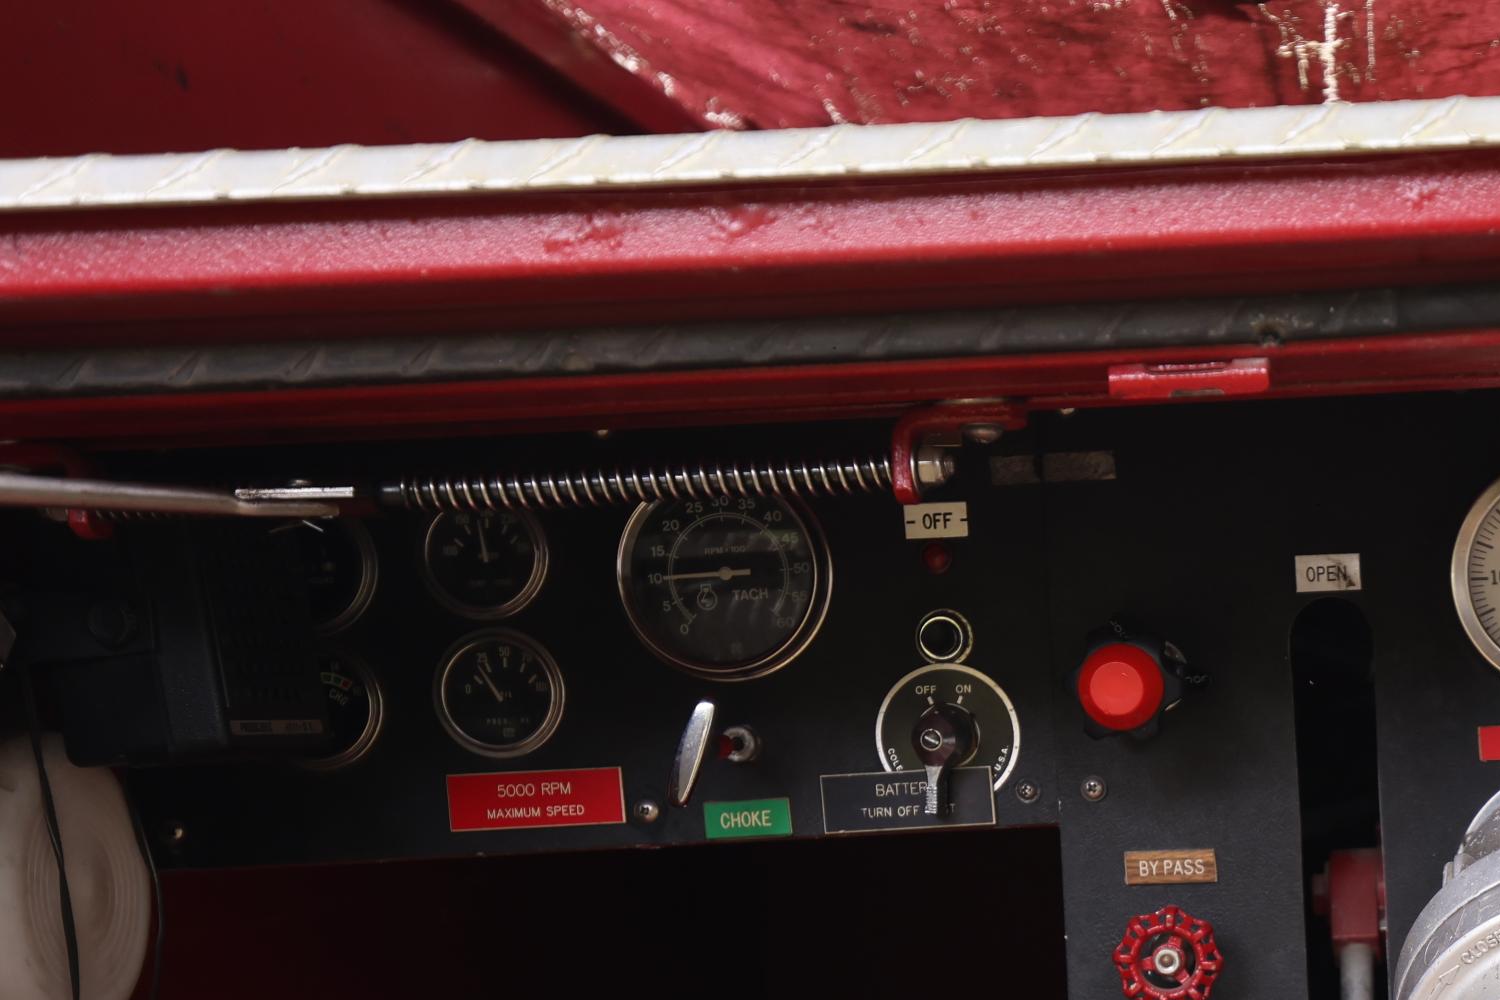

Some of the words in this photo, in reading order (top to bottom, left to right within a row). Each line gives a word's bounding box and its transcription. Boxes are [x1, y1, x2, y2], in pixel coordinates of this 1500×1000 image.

[685, 501, 703, 514] 25
[763, 510, 782, 523] 40
[922, 512, 952, 529] OFF
[661, 519, 680, 532] 20
[651, 545, 665, 558] 15
[648, 573, 663, 585] 10
[1306, 565, 1347, 582] OPEN
[732, 588, 769, 601] TACH
[915, 685, 936, 695] OFF
[955, 684, 971, 694] ON
[497, 783, 535, 798] 5000
[541, 781, 572, 796] RPM
[875, 781, 930, 797] BATTER
[486, 806, 541, 820] MAXIMUM
[546, 804, 585, 817] SPEED
[860, 805, 892, 818] TURN
[897, 805, 919, 817] OFF
[720, 809, 772, 830] CHOKE
[1139, 859, 1159, 877] BY
[1163, 858, 1205, 876] PASS
